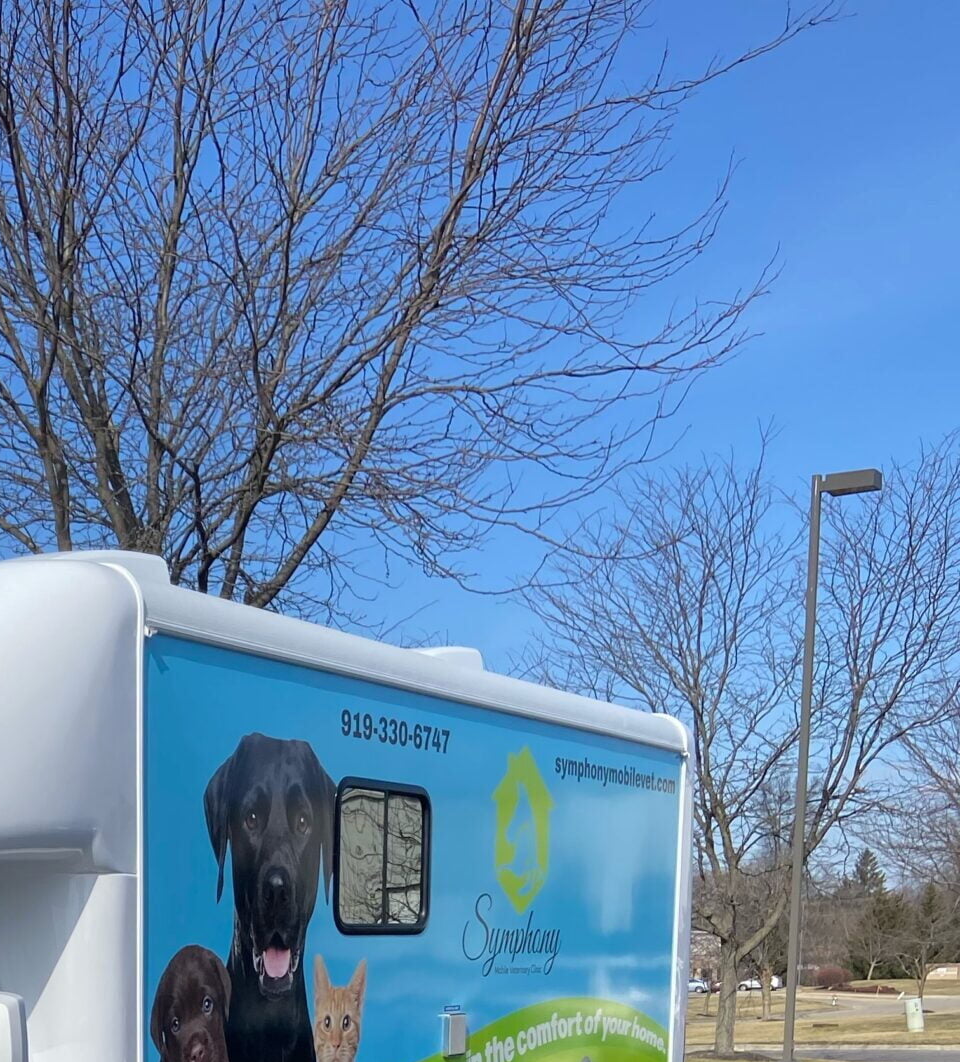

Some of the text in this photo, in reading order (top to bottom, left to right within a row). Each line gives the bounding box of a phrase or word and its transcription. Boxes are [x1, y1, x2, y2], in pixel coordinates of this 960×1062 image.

[341, 709, 451, 754] 919-330-6747
[554, 755, 676, 795] symphonymobilevet.com
[462, 893, 562, 977] Symphony
[516, 1012, 583, 1056] comfort
[584, 1008, 603, 1034] of
[602, 1014, 632, 1042] your
